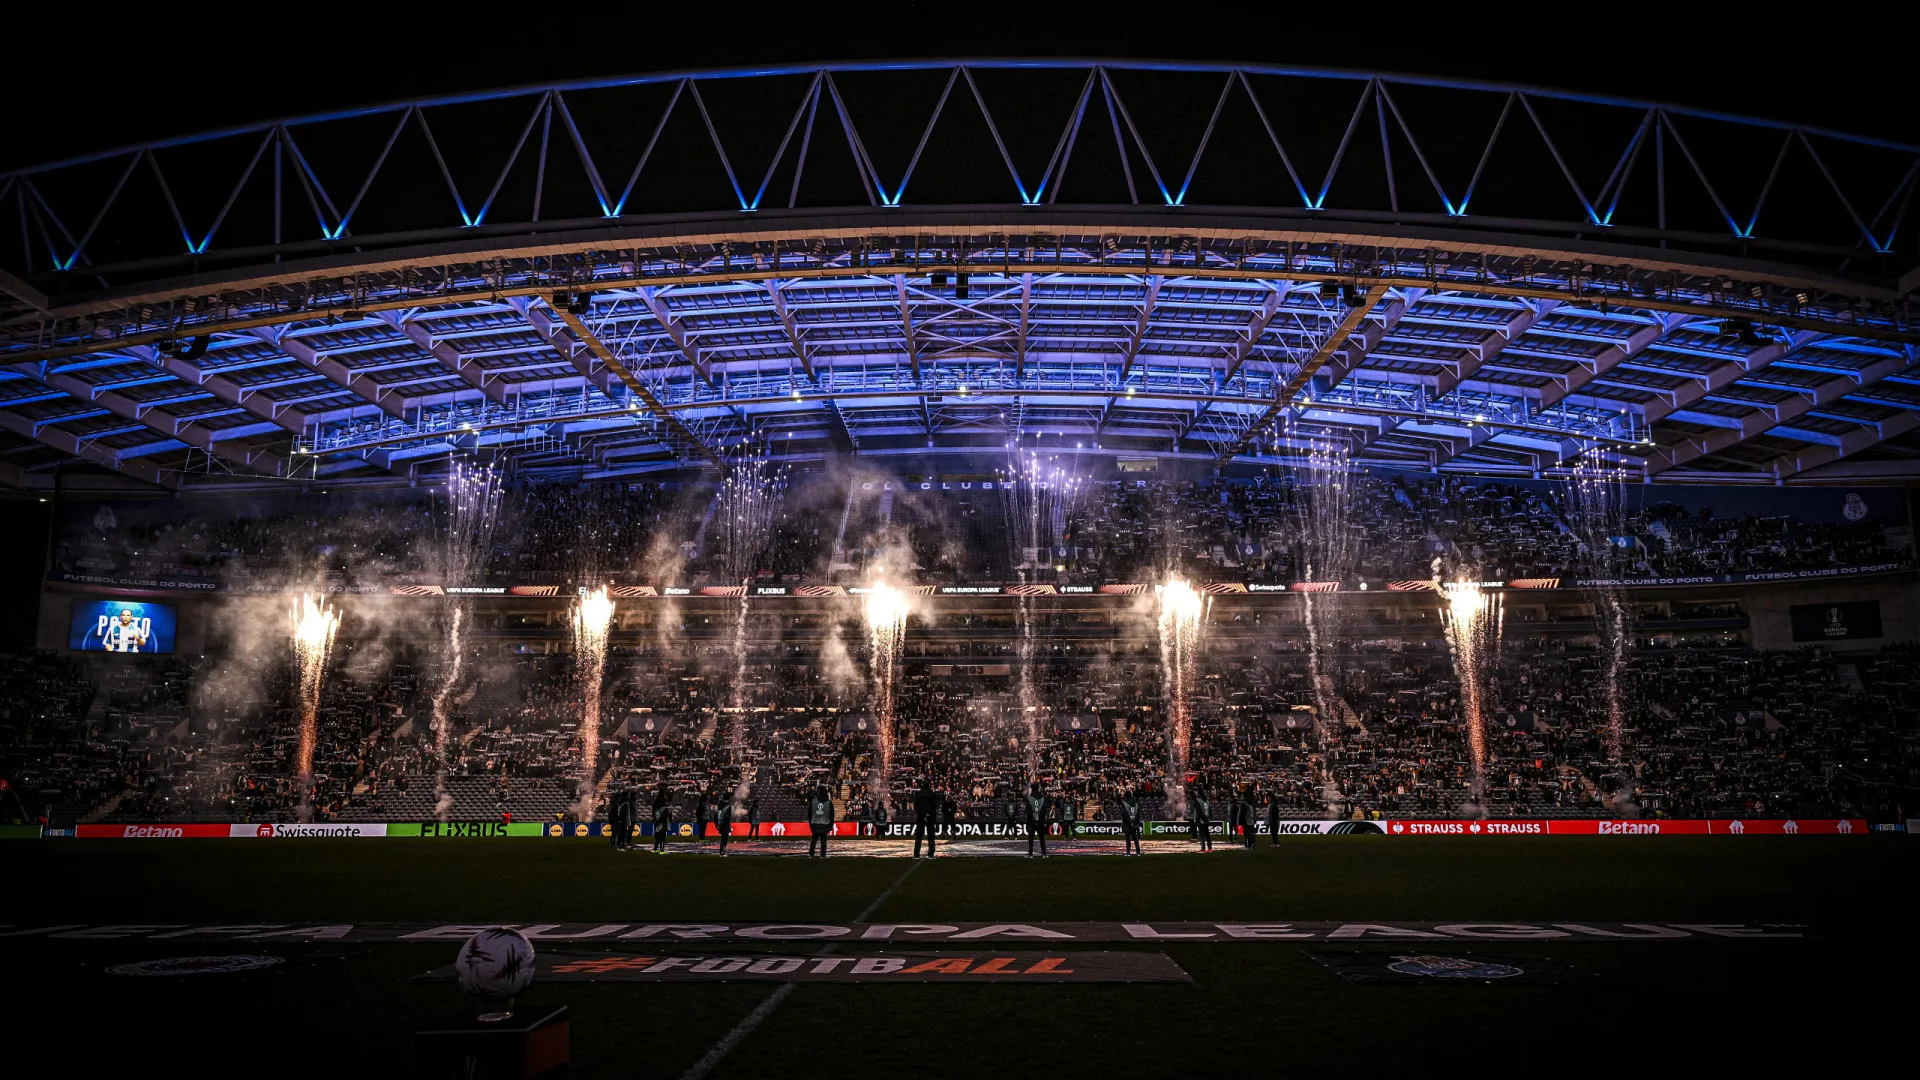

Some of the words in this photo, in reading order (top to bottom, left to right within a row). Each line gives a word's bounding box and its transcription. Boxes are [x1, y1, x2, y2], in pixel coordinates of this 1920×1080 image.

[64, 573, 117, 584] FUTEBOL
[120, 578, 157, 587] CLUBE
[1677, 576, 1714, 584] PORTO
[1746, 572, 1796, 581] FUTEBOL
[1800, 568, 1838, 577] CLUBE
[97, 615, 151, 638] POTO
[124, 825, 183, 838] Betano
[275, 825, 360, 837] Swissquote
[1410, 823, 1463, 834] STRAUSS
[1487, 823, 1541, 834] STRAUSS
[1598, 821, 1660, 835] Betano
[1121, 924, 1804, 939] LEAGUE
[552, 956, 1074, 974] #FOOTBALL
